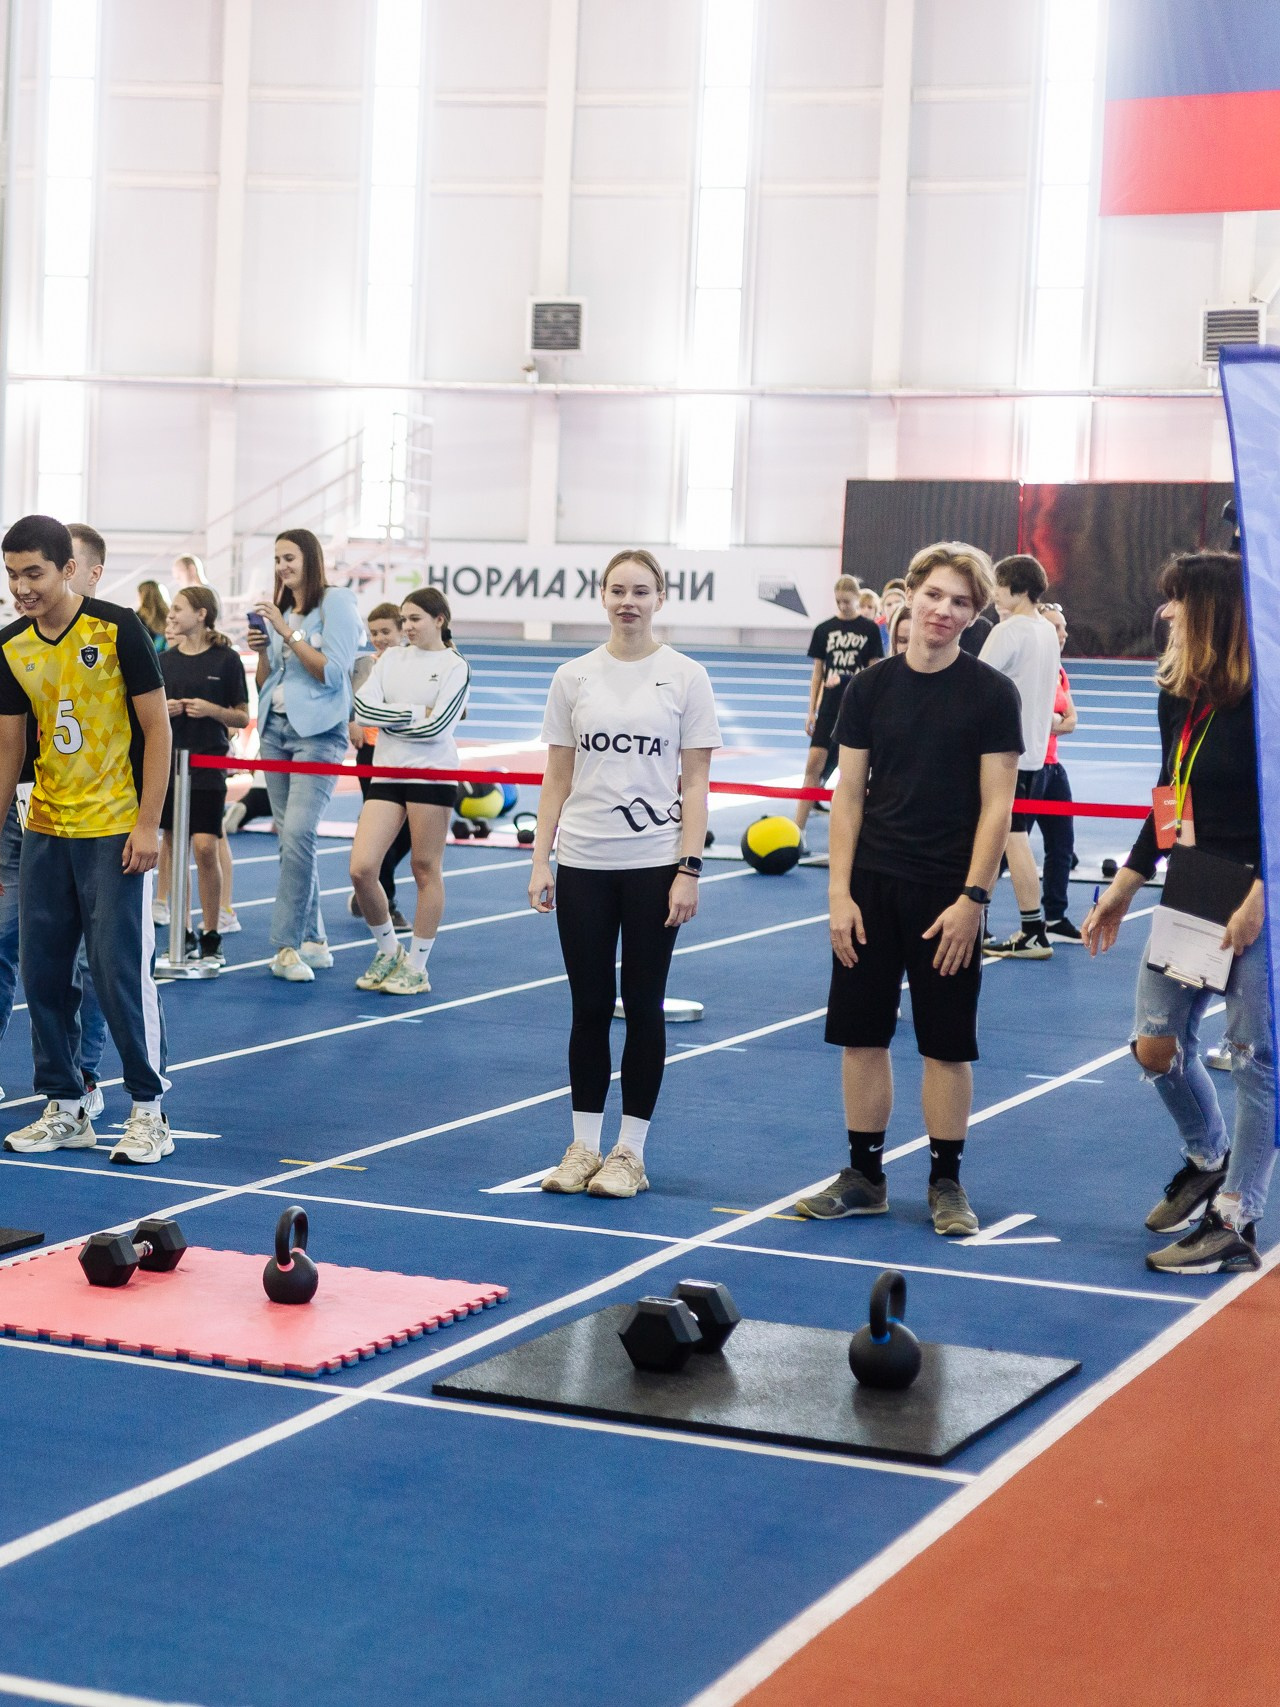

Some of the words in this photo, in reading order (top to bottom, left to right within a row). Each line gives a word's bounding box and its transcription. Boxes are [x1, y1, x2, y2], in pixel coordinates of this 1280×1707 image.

[429, 566, 565, 598] НОРМА
[575, 569, 714, 602] ЖНИ
[826, 630, 868, 653] ENJOY
[832, 650, 859, 666] THE
[53, 699, 84, 755] 5
[577, 732, 662, 757] NOCTA
